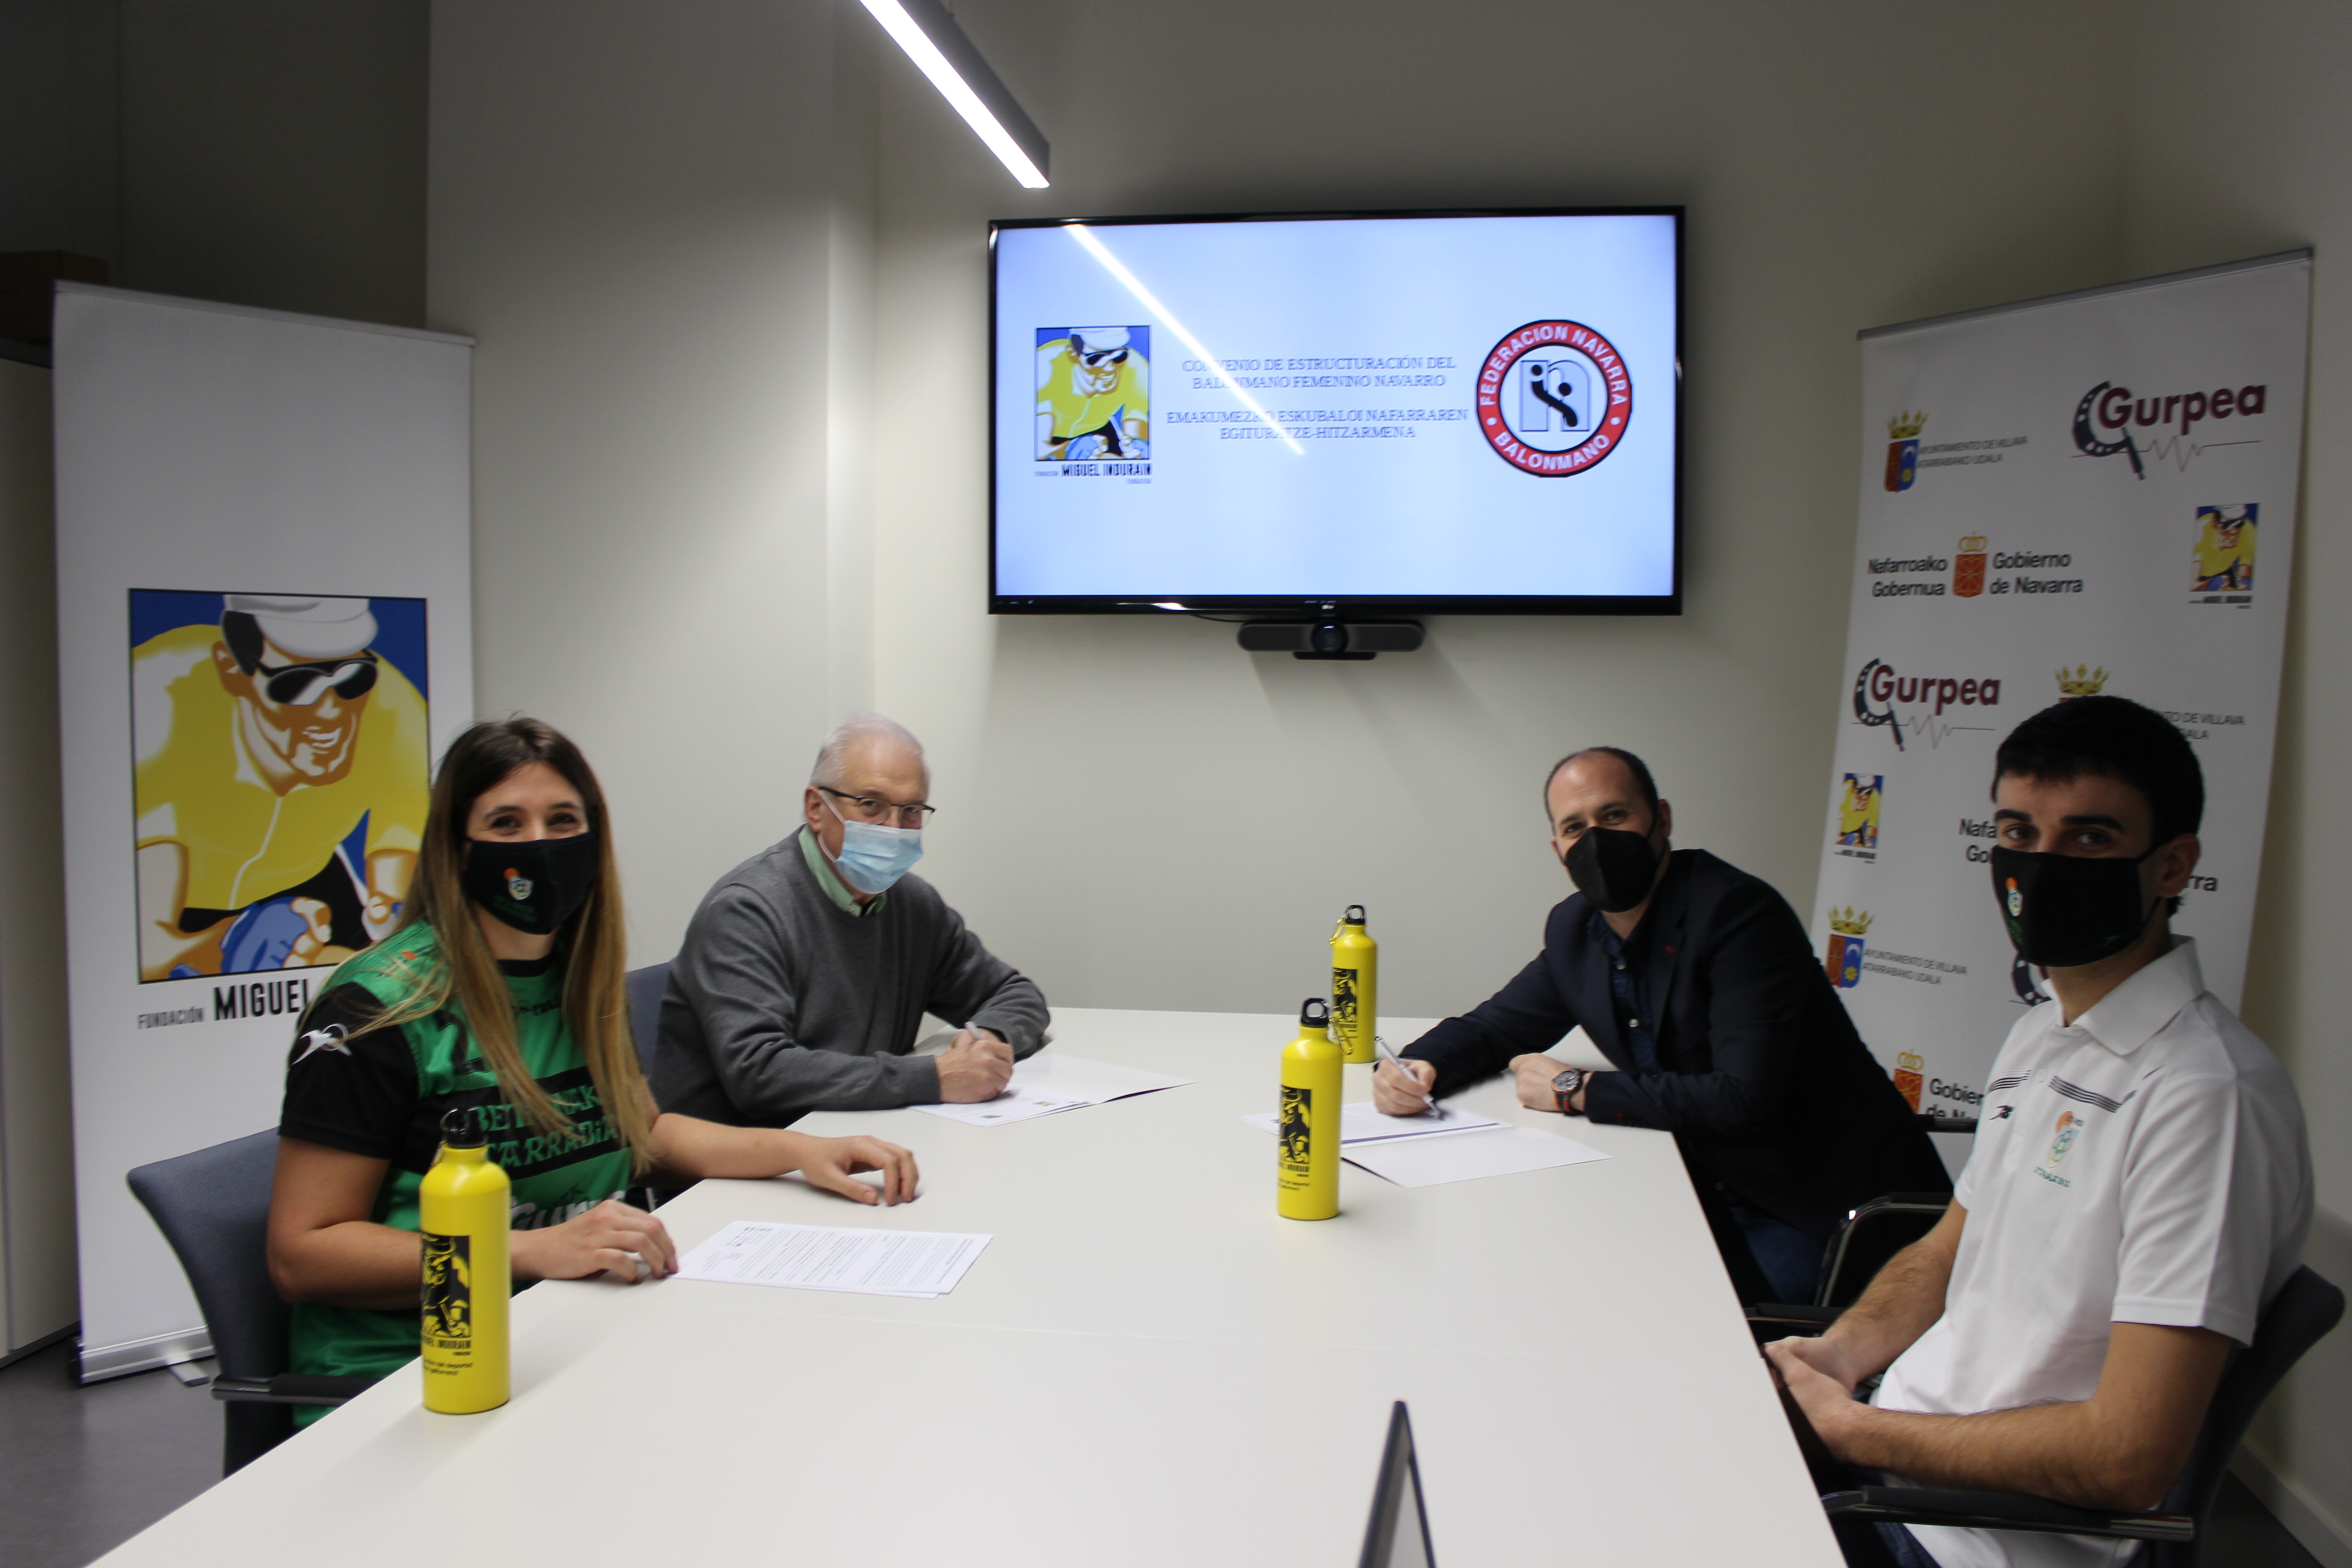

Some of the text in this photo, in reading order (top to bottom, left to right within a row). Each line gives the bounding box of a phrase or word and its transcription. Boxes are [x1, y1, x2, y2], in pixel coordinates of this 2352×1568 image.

[1263, 359, 1284, 371] DE
[1287, 355, 1423, 371] ESTRUCTURACIÓN
[1426, 356, 1456, 369] DEL
[1480, 325, 1629, 406] FEDERACION NAVARRA
[1292, 375, 1371, 388] FEMENINO
[1374, 374, 1446, 387] NAVARRO
[1278, 409, 1363, 422] ESKUBALOI
[1364, 409, 1469, 421] NAFARRAREN
[2098, 384, 2266, 436] Gurpea
[1494, 431, 1610, 470] BALONMANO
[1868, 555, 1949, 574] Nafarroako
[1993, 551, 2072, 569] Gobierno
[1872, 581, 1946, 597] Gobernua
[1989, 577, 2084, 594] de Navarra
[1870, 664, 2000, 715] Gurpea
[1930, 1078, 1984, 1106] Gobier
